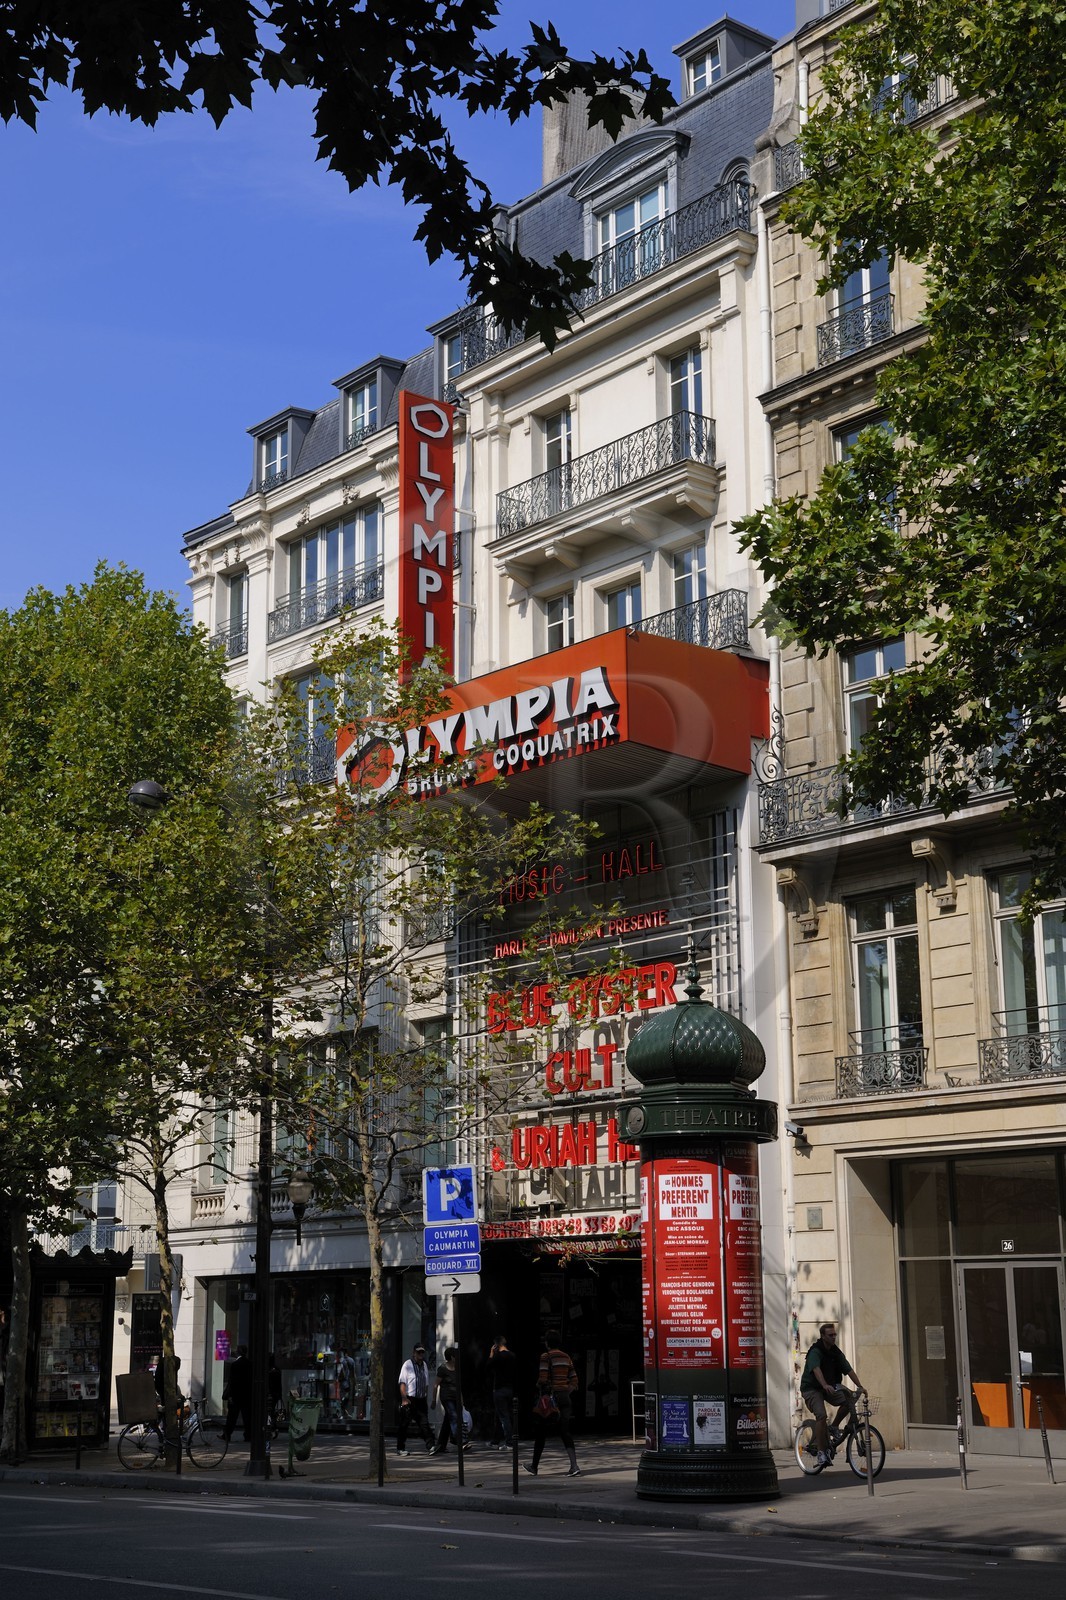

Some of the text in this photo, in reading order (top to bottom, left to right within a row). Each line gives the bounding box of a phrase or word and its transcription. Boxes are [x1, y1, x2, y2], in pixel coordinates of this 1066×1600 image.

[336, 667, 617, 802] OLYMPIA
[493, 714, 617, 770] COQUATRIX
[601, 840, 664, 884] HALL
[545, 1043, 618, 1095] CULT
[660, 1108, 758, 1127] THEATRE
[491, 1147, 505, 1172] &
[513, 1121, 597, 1170] URIAH
[671, 1176, 704, 1188] HOMMES
[440, 1177, 462, 1212] P
[661, 1189, 709, 1205] PREFERENT
[671, 1206, 699, 1218] MENTIR
[434, 1229, 469, 1241] OLYMPIA
[428, 1240, 476, 1253] CAUMARTIN
[1002, 1240, 1013, 1251] 26
[427, 1257, 479, 1272] EDOUARD VII
